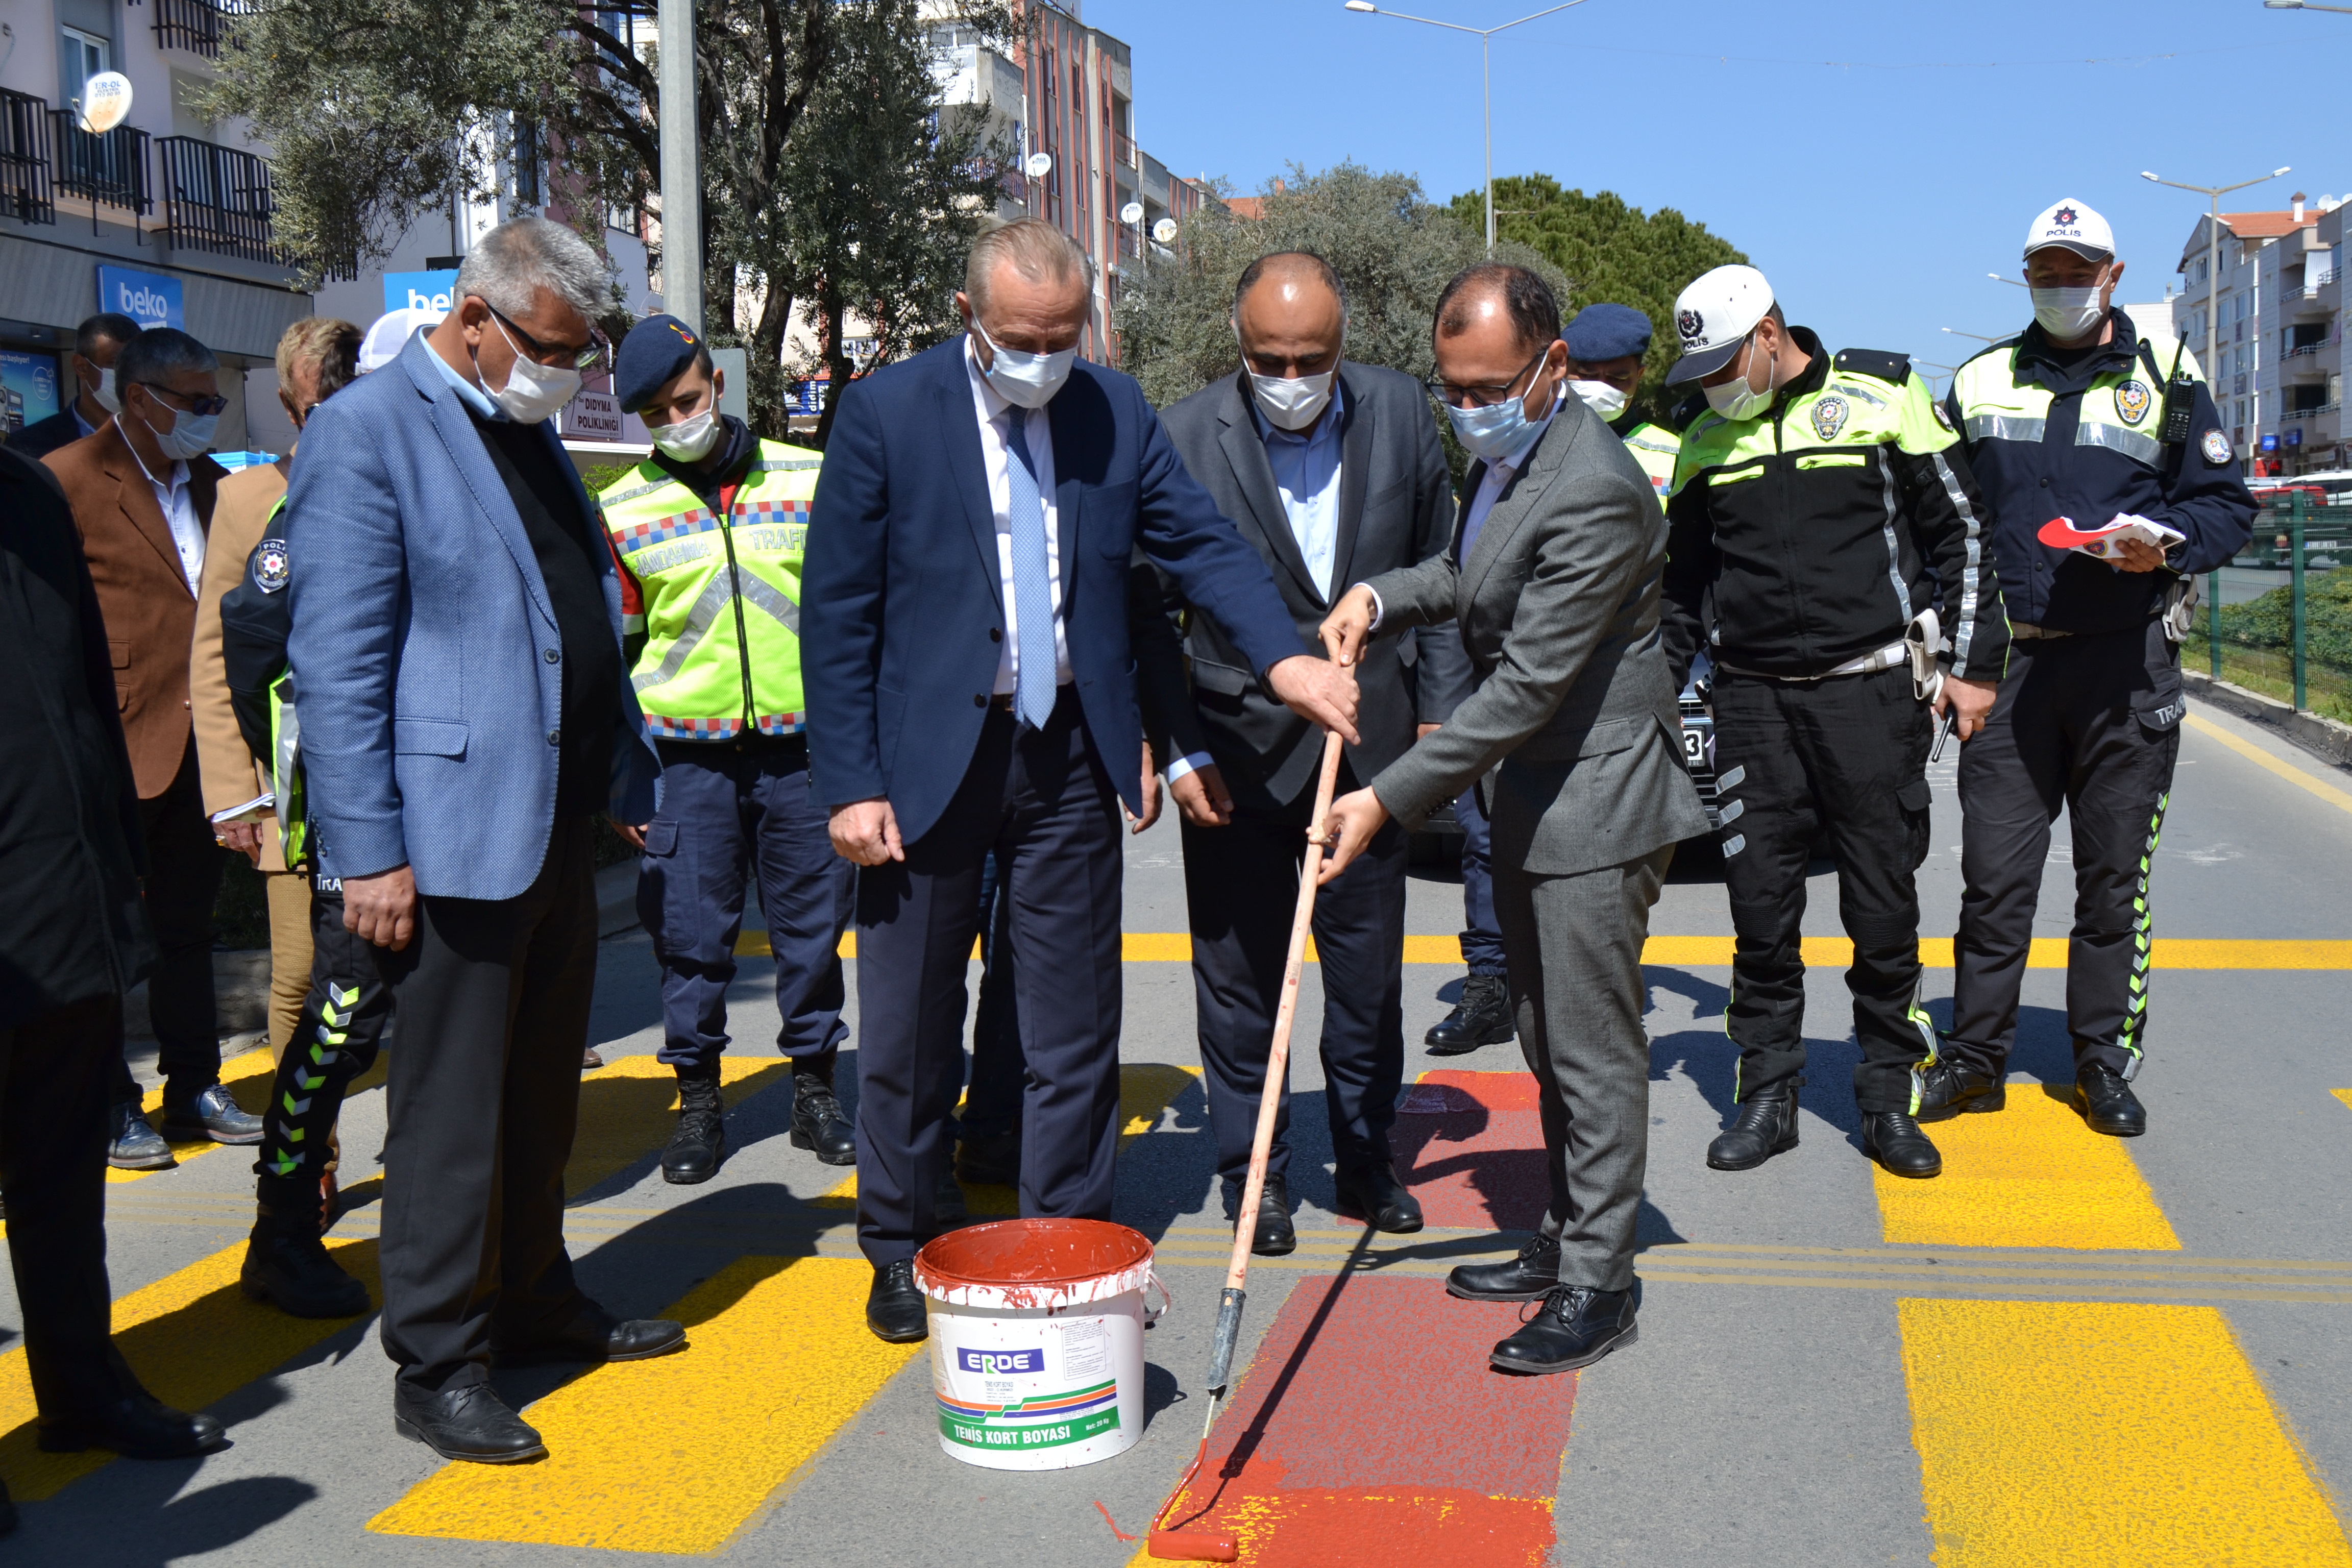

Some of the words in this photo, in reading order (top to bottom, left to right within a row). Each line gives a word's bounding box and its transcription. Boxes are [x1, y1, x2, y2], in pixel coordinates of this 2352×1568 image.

[120, 281, 167, 318] beko
[585, 398, 611, 413] DIDYMA
[807, 381, 817, 411] didim
[578, 414, 619, 431] POLİKLİNİĞİ
[749, 528, 807, 551] TRAFİ
[635, 537, 711, 577] JANDARMA
[1685, 733, 1700, 756] 3
[967, 1353, 1030, 1374] ERDE
[954, 1424, 983, 1443] TENİS
[986, 1431, 1018, 1444] KORT
[1022, 1425, 1070, 1444] BOYASI
